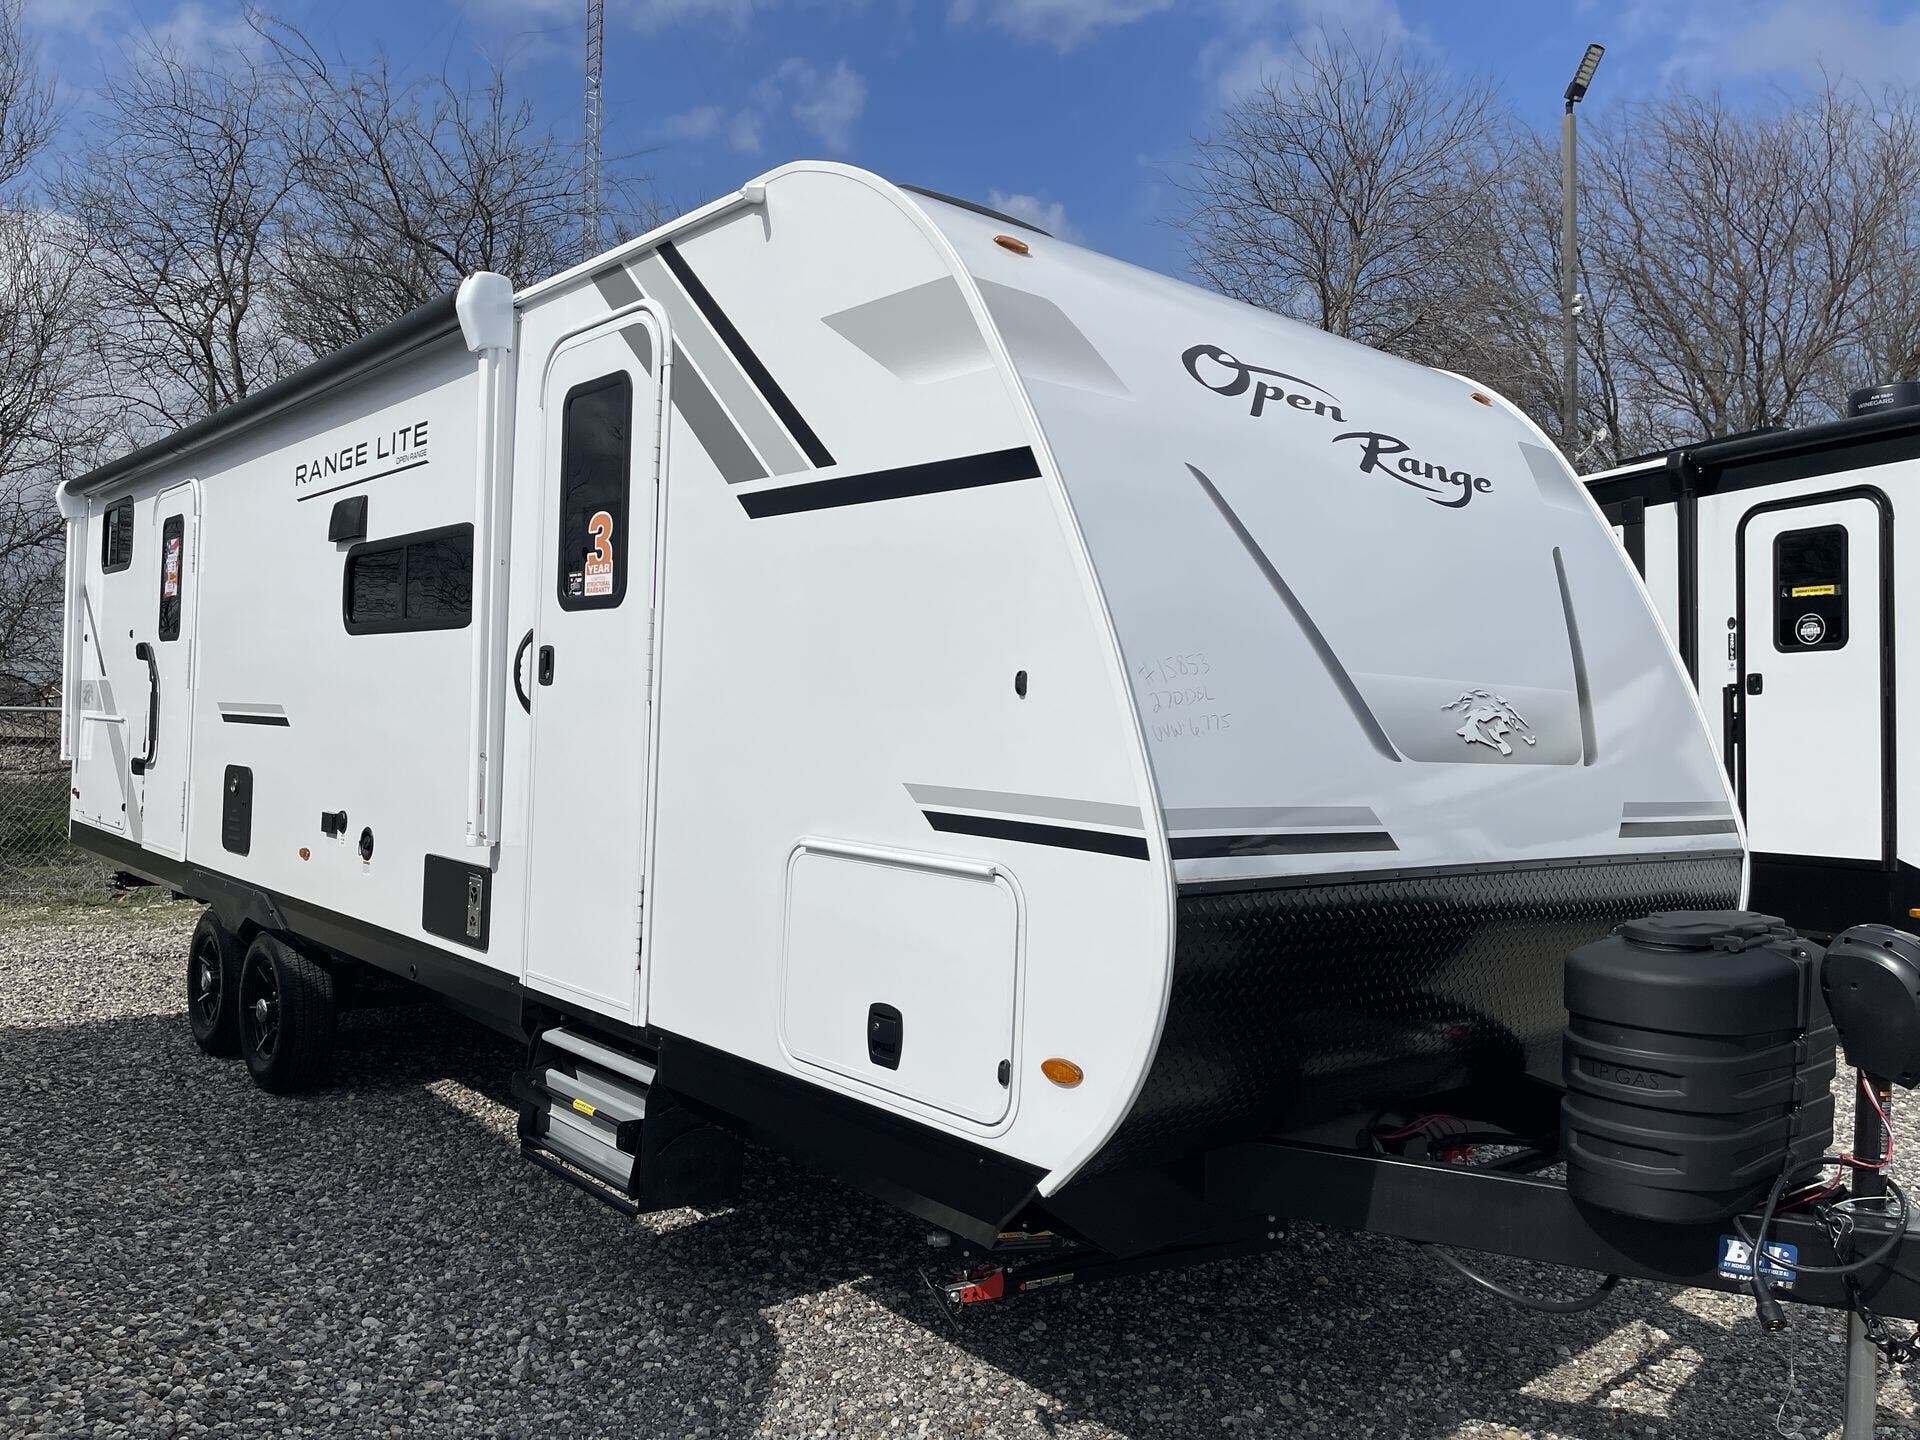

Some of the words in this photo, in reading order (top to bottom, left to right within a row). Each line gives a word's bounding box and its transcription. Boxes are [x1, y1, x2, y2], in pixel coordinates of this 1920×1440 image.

[1181, 344, 1348, 422] Open
[1857, 398, 1894, 409] WINEGARD
[295, 442, 368, 486] RANGE
[377, 420, 428, 459] LITE
[396, 453, 409, 465] OPEN
[409, 449, 428, 461] RANGE
[1332, 431, 1495, 508] Range
[587, 510, 613, 564] 3
[588, 564, 610, 574] YEAR
[1615, 1067, 1659, 1090] GAS
